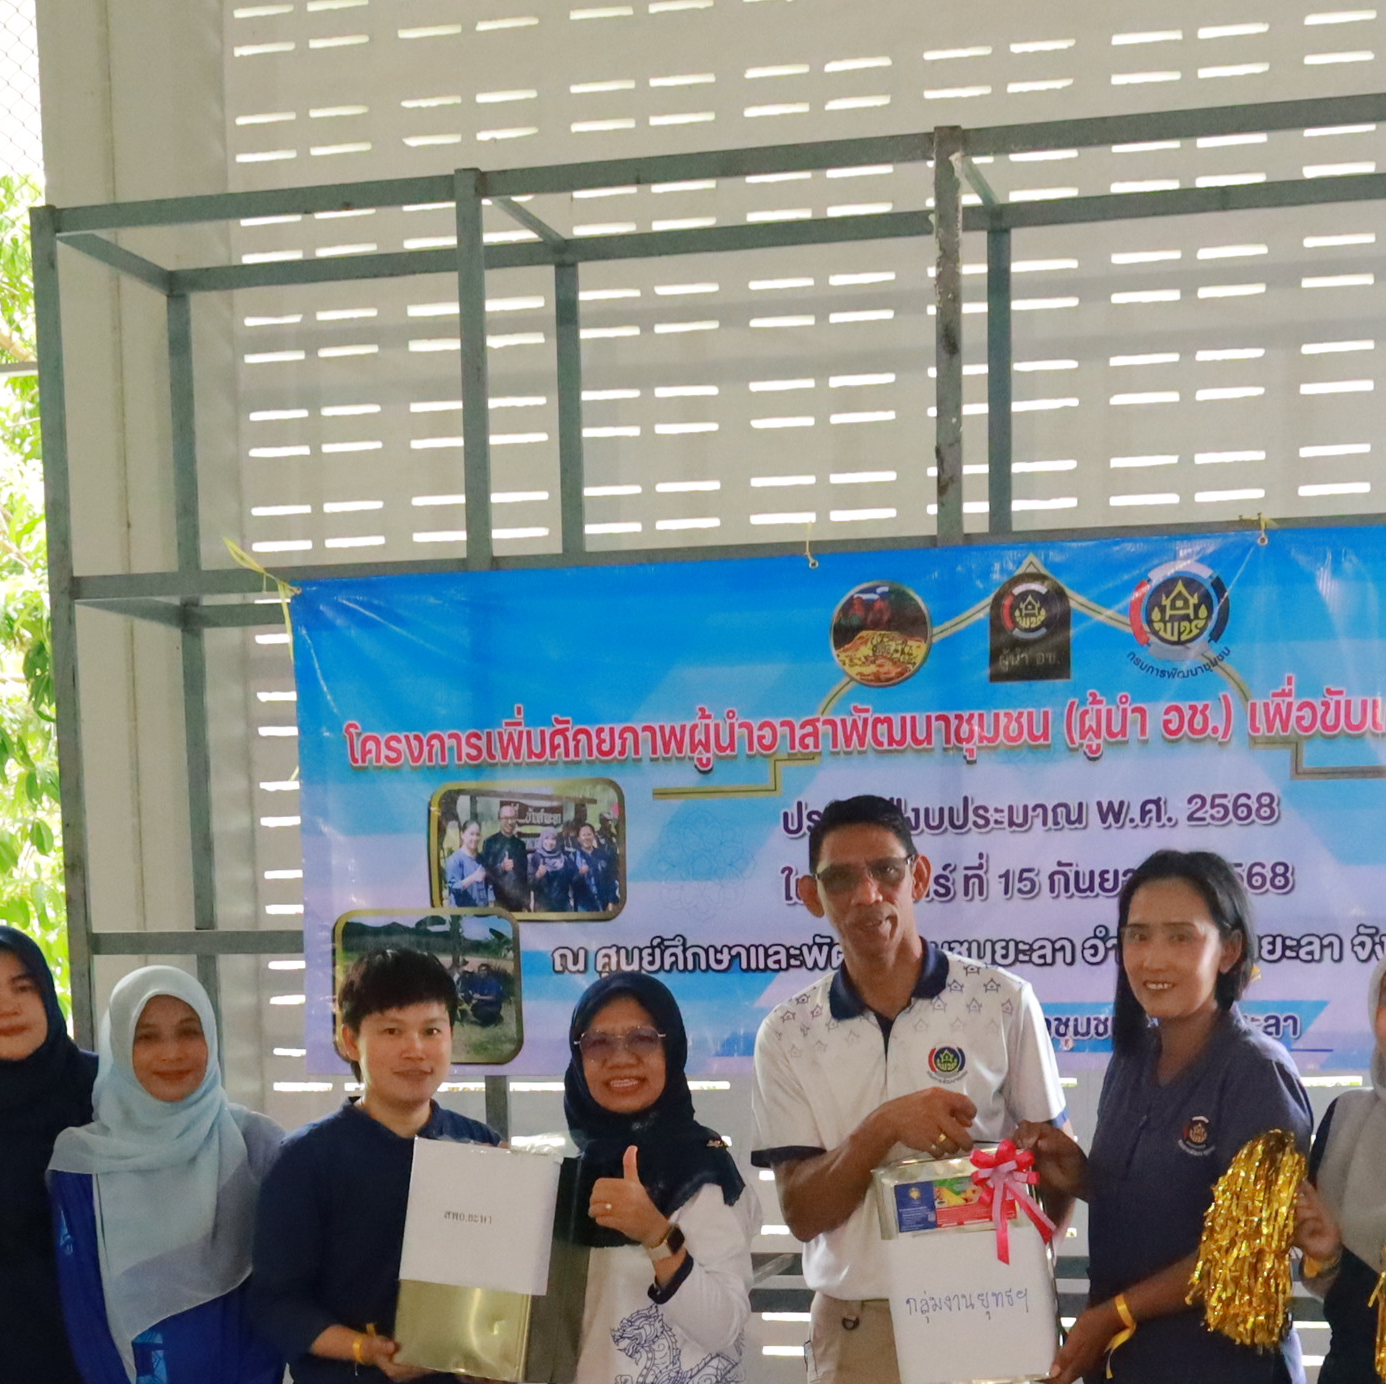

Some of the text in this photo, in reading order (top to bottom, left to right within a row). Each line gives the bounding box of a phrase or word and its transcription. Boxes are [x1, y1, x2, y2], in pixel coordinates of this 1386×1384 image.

[344, 703, 1051, 770] โครงการเพิ่มศักยภาพผู้นำอาสาพัฒนาชุมชน
[1065, 689, 1148, 756] (ผู้นำ
[1161, 694, 1233, 743] อช.)
[1097, 796, 1175, 825] พ.ศ.
[1186, 792, 1277, 824] 2568
[963, 852, 986, 899] ที่
[997, 867, 1037, 897] 15
[551, 946, 587, 973] ณ
